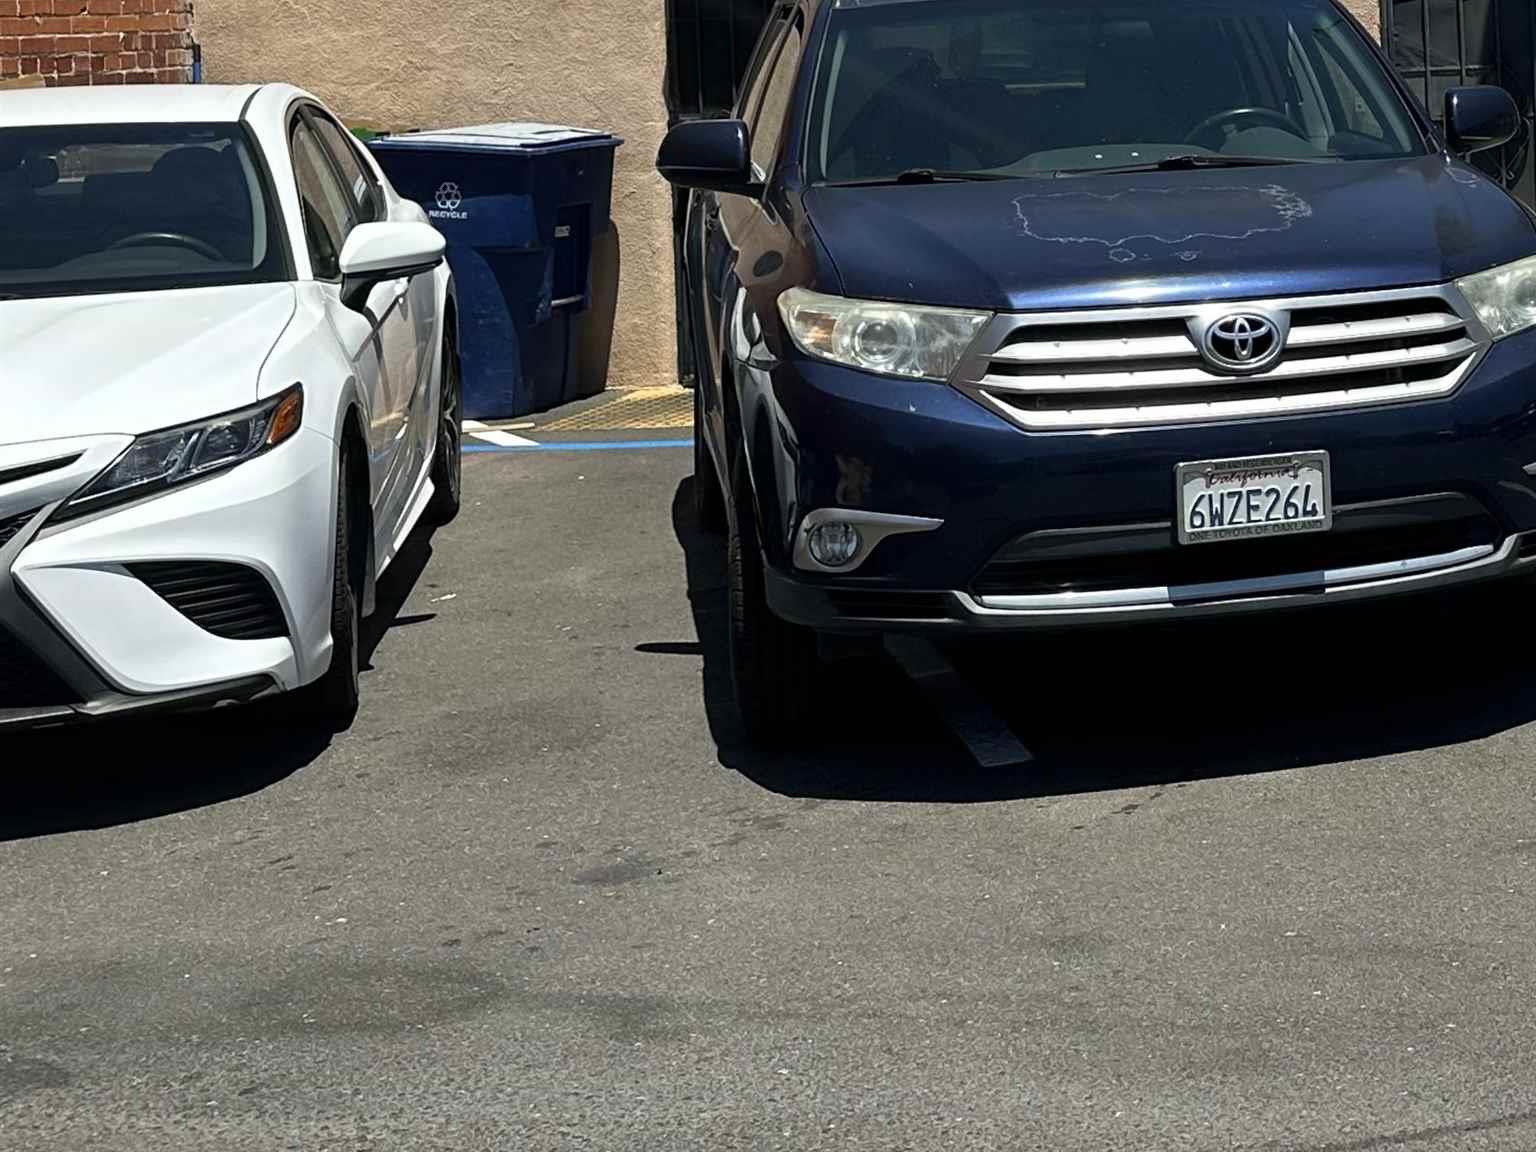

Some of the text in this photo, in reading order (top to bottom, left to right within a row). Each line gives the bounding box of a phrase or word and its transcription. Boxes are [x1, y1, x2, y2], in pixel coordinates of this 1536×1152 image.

[428, 209, 468, 220] RECYCLE
[1190, 483, 1319, 529] 6WZE264
[1214, 527, 1255, 539] TOYOTA
[1255, 524, 1270, 535] OF
